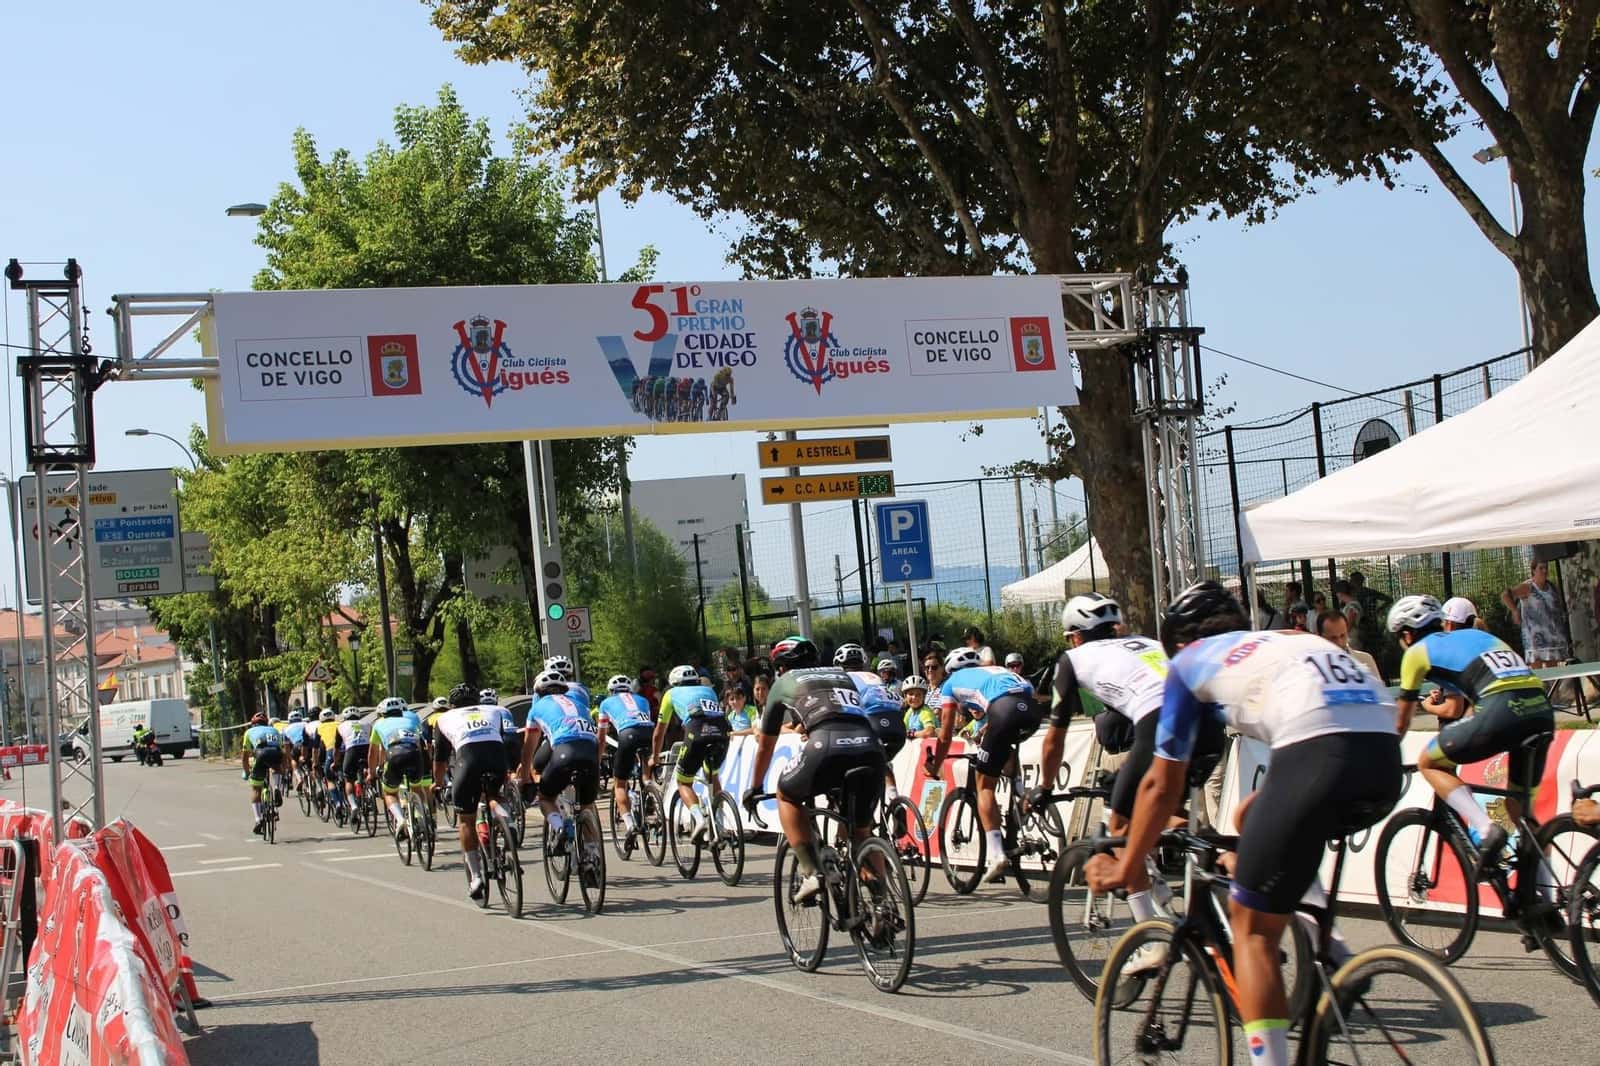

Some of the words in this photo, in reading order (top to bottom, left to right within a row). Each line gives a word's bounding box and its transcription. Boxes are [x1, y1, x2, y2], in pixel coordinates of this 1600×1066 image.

[694, 299, 743, 314] GRAN
[677, 315, 745, 332] PREMIO
[684, 333, 757, 350] CIDADE
[914, 330, 999, 345] CONCELLO
[246, 350, 353, 368] CONCELLO
[676, 352, 703, 368] DE
[706, 350, 757, 367] VIGO
[829, 348, 850, 357] Club
[853, 347, 887, 356] Ciclista
[926, 349, 948, 362] DE
[952, 348, 992, 361] VIGO
[502, 358, 525, 367] Club
[528, 357, 567, 367] Ciclista
[261, 372, 288, 387] DE
[294, 370, 342, 386] VIGO
[796, 447, 804, 458] A
[807, 446, 851, 458] ESTRELA
[795, 484, 816, 495] C.C.
[819, 482, 826, 493] A
[830, 481, 855, 492] LAXE
[120, 517, 172, 527] Pontevedra
[889, 510, 914, 541] P
[892, 547, 918, 556] AREAL
[117, 569, 159, 579] BOUZAS
[1305, 653, 1365, 684] 163
